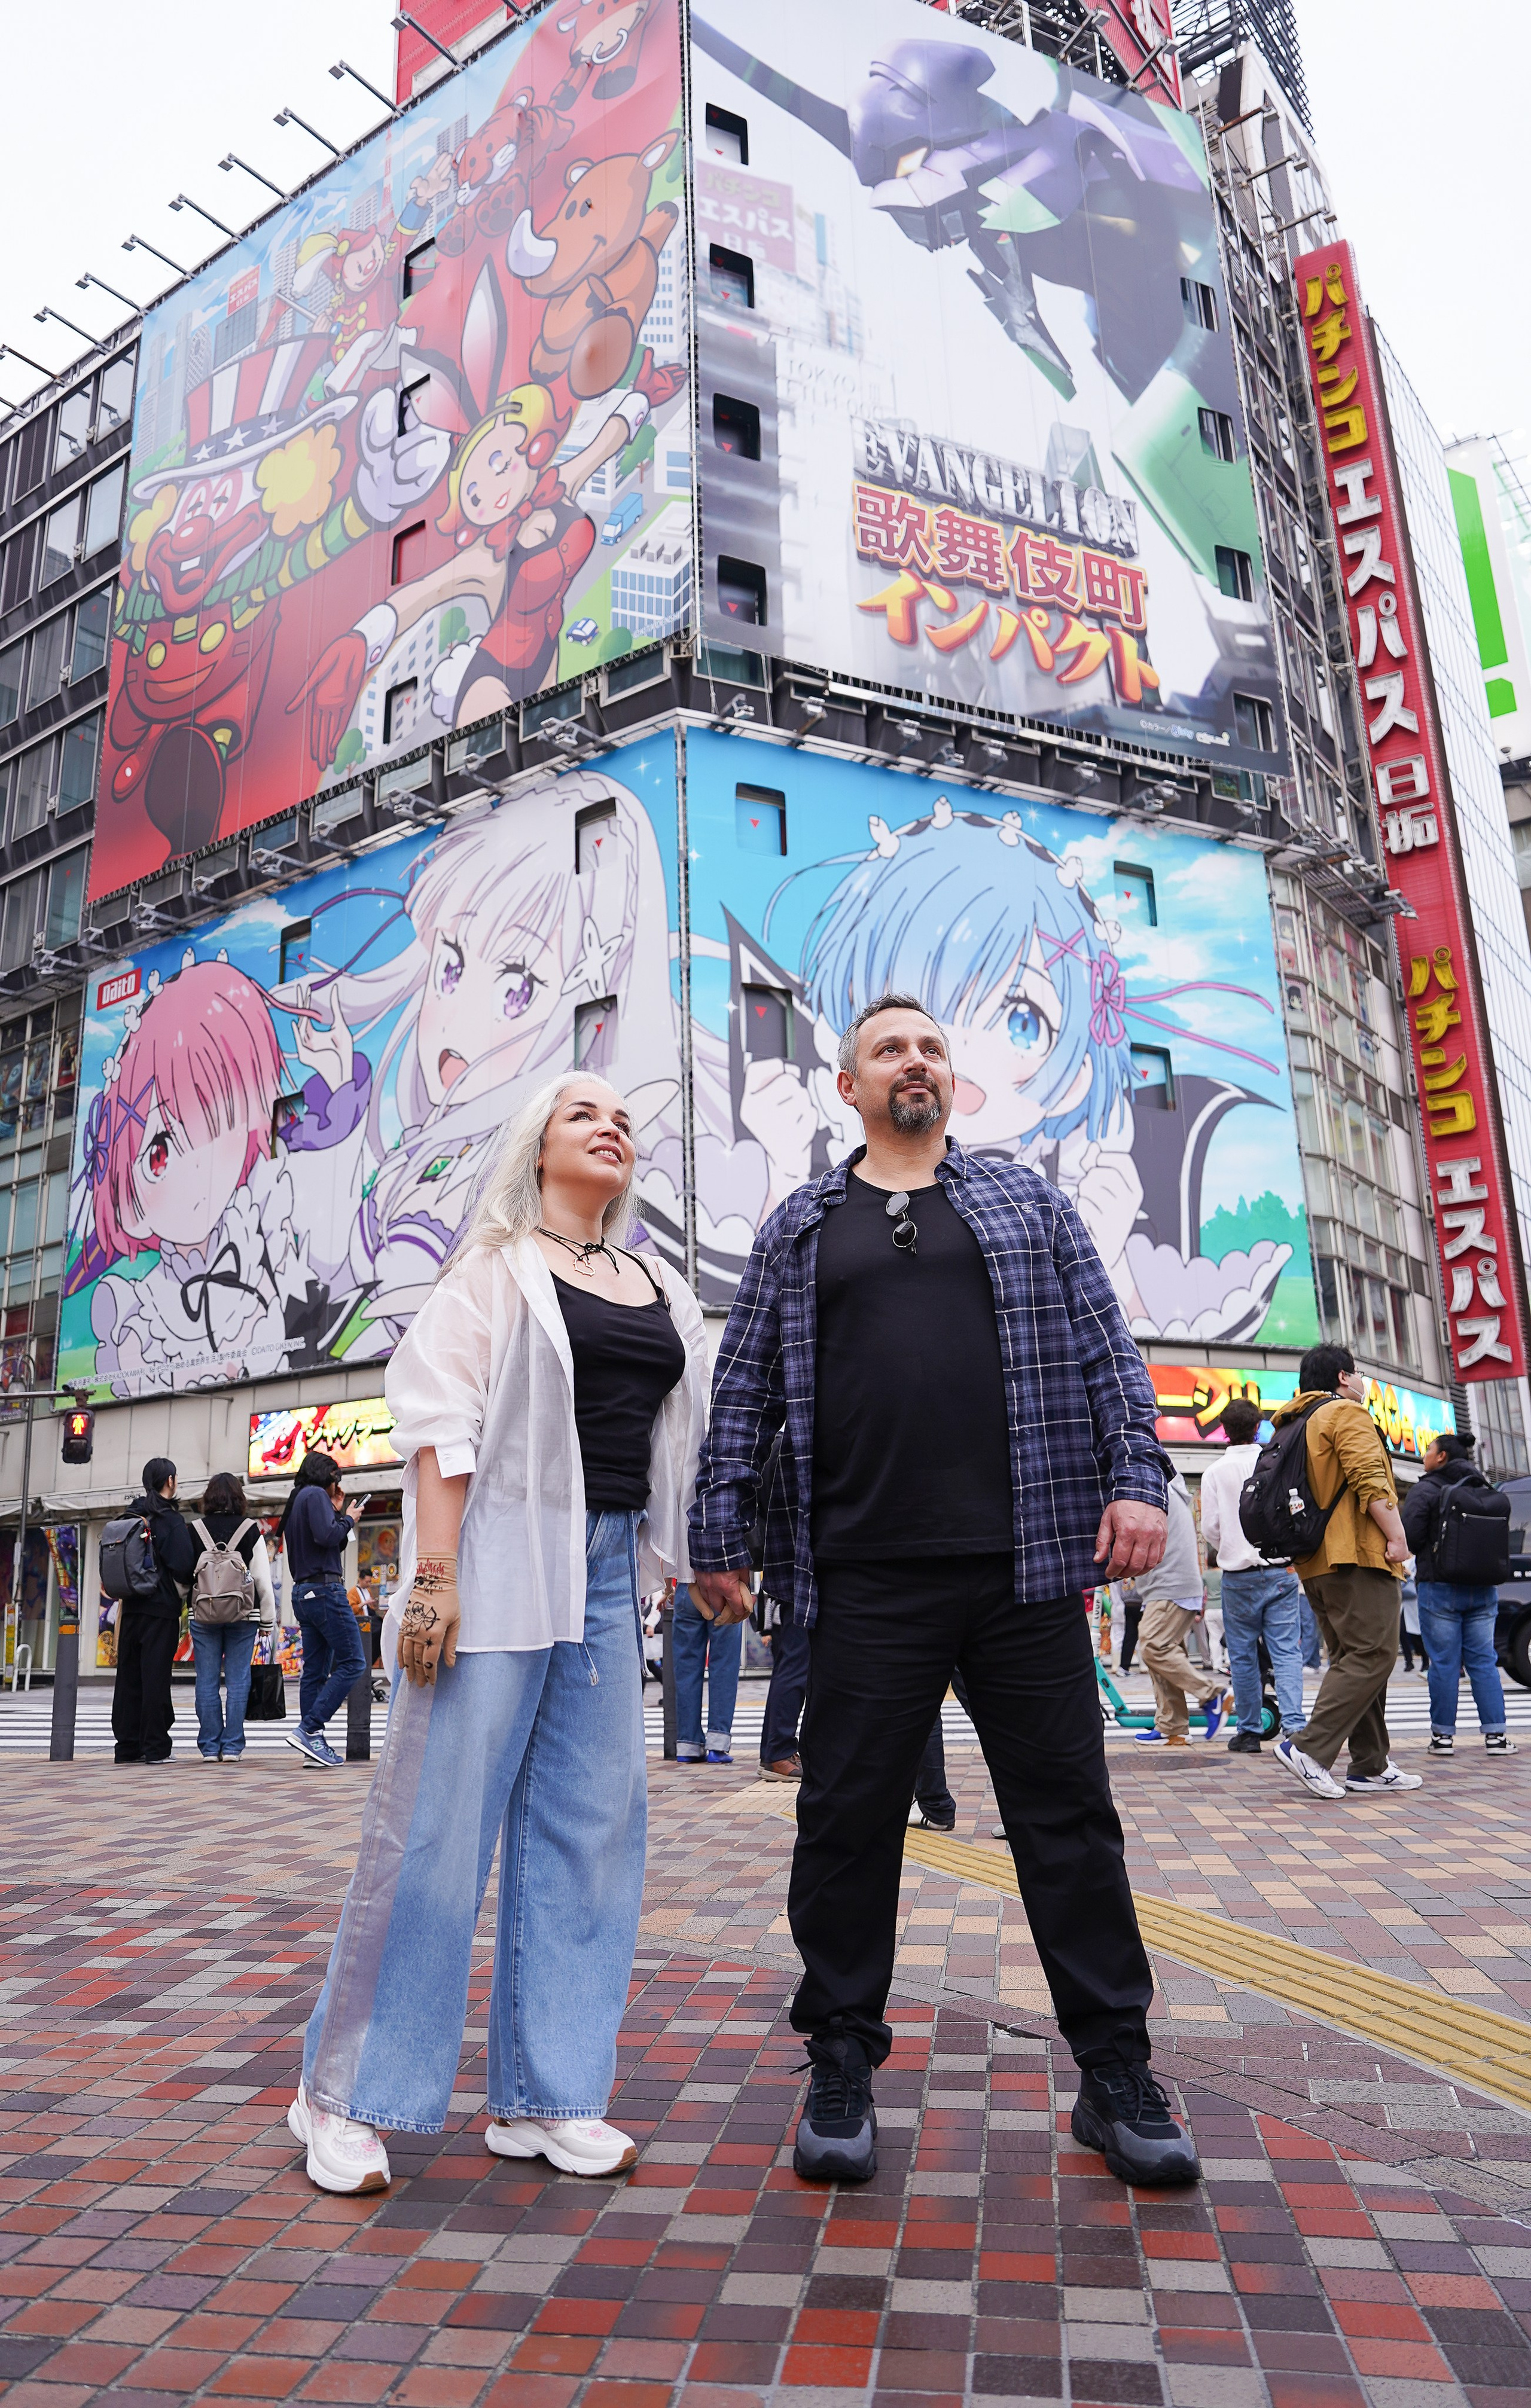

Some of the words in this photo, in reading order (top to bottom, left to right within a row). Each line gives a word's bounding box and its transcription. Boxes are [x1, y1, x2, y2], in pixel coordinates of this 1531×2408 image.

[698, 195, 793, 242] エスパス
[1304, 264, 1368, 453] パチンコ
[853, 418, 1139, 557] EVANGELION
[854, 481, 1146, 629] 歌舞伎町
[856, 567, 1159, 702] インパクト
[1407, 945, 1476, 1136] パチンコ
[1436, 1156, 1513, 1369] エスパス
